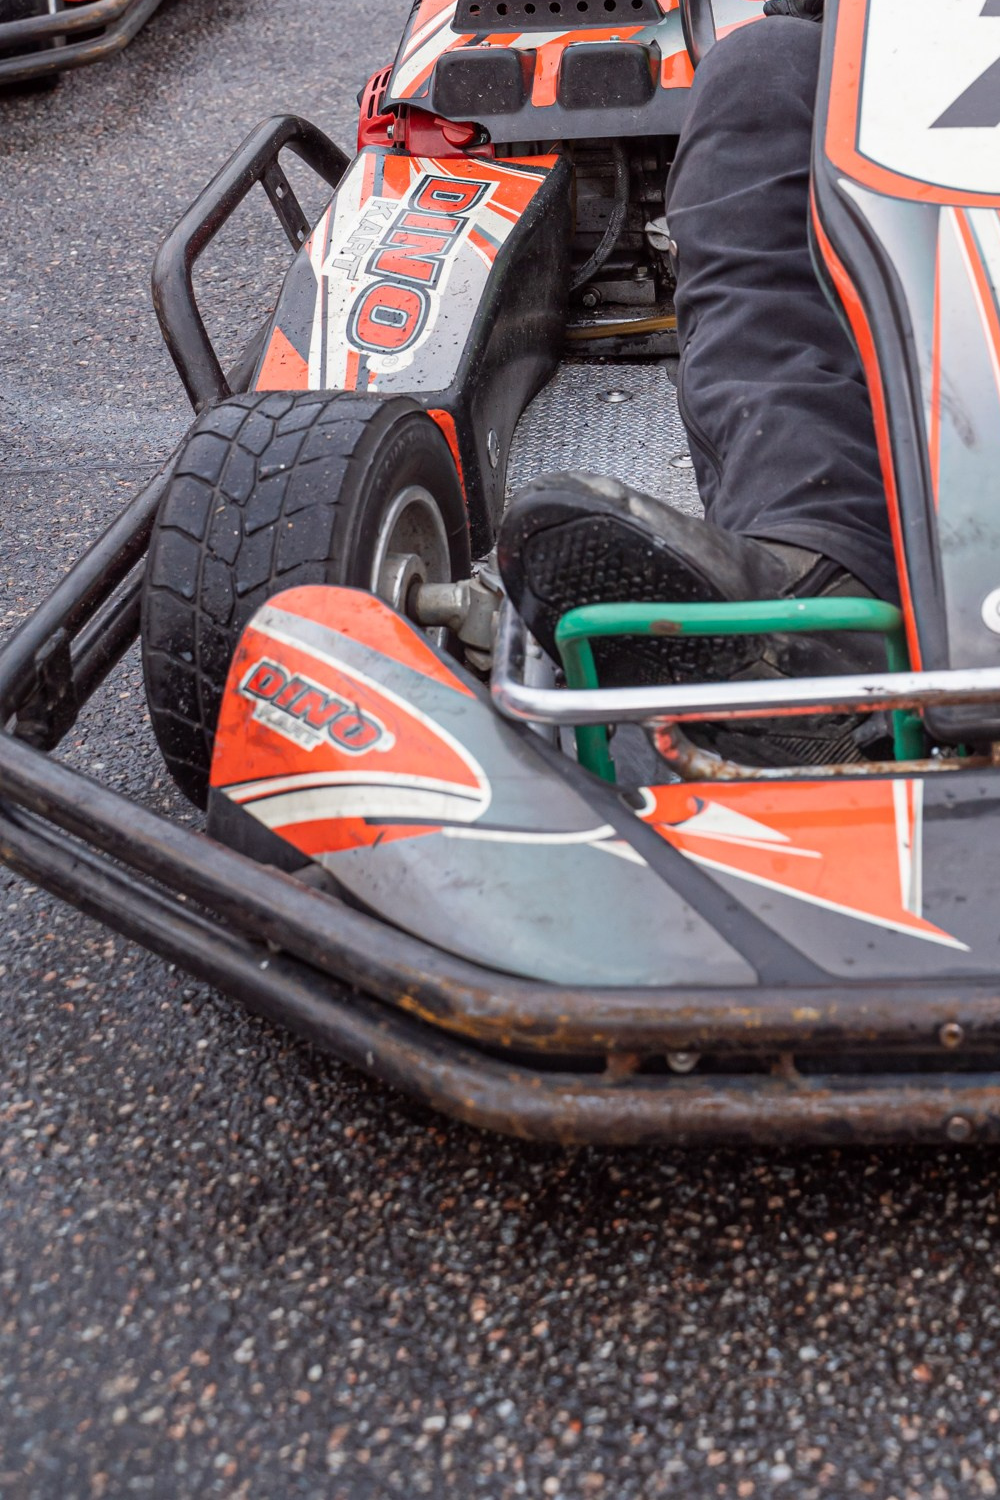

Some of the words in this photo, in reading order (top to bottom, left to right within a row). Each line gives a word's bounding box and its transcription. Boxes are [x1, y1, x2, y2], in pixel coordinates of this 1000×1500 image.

[331, 199, 398, 281] KART
[345, 173, 492, 356] DINO
[242, 660, 383, 752] DINO
[256, 703, 321, 746] KART
